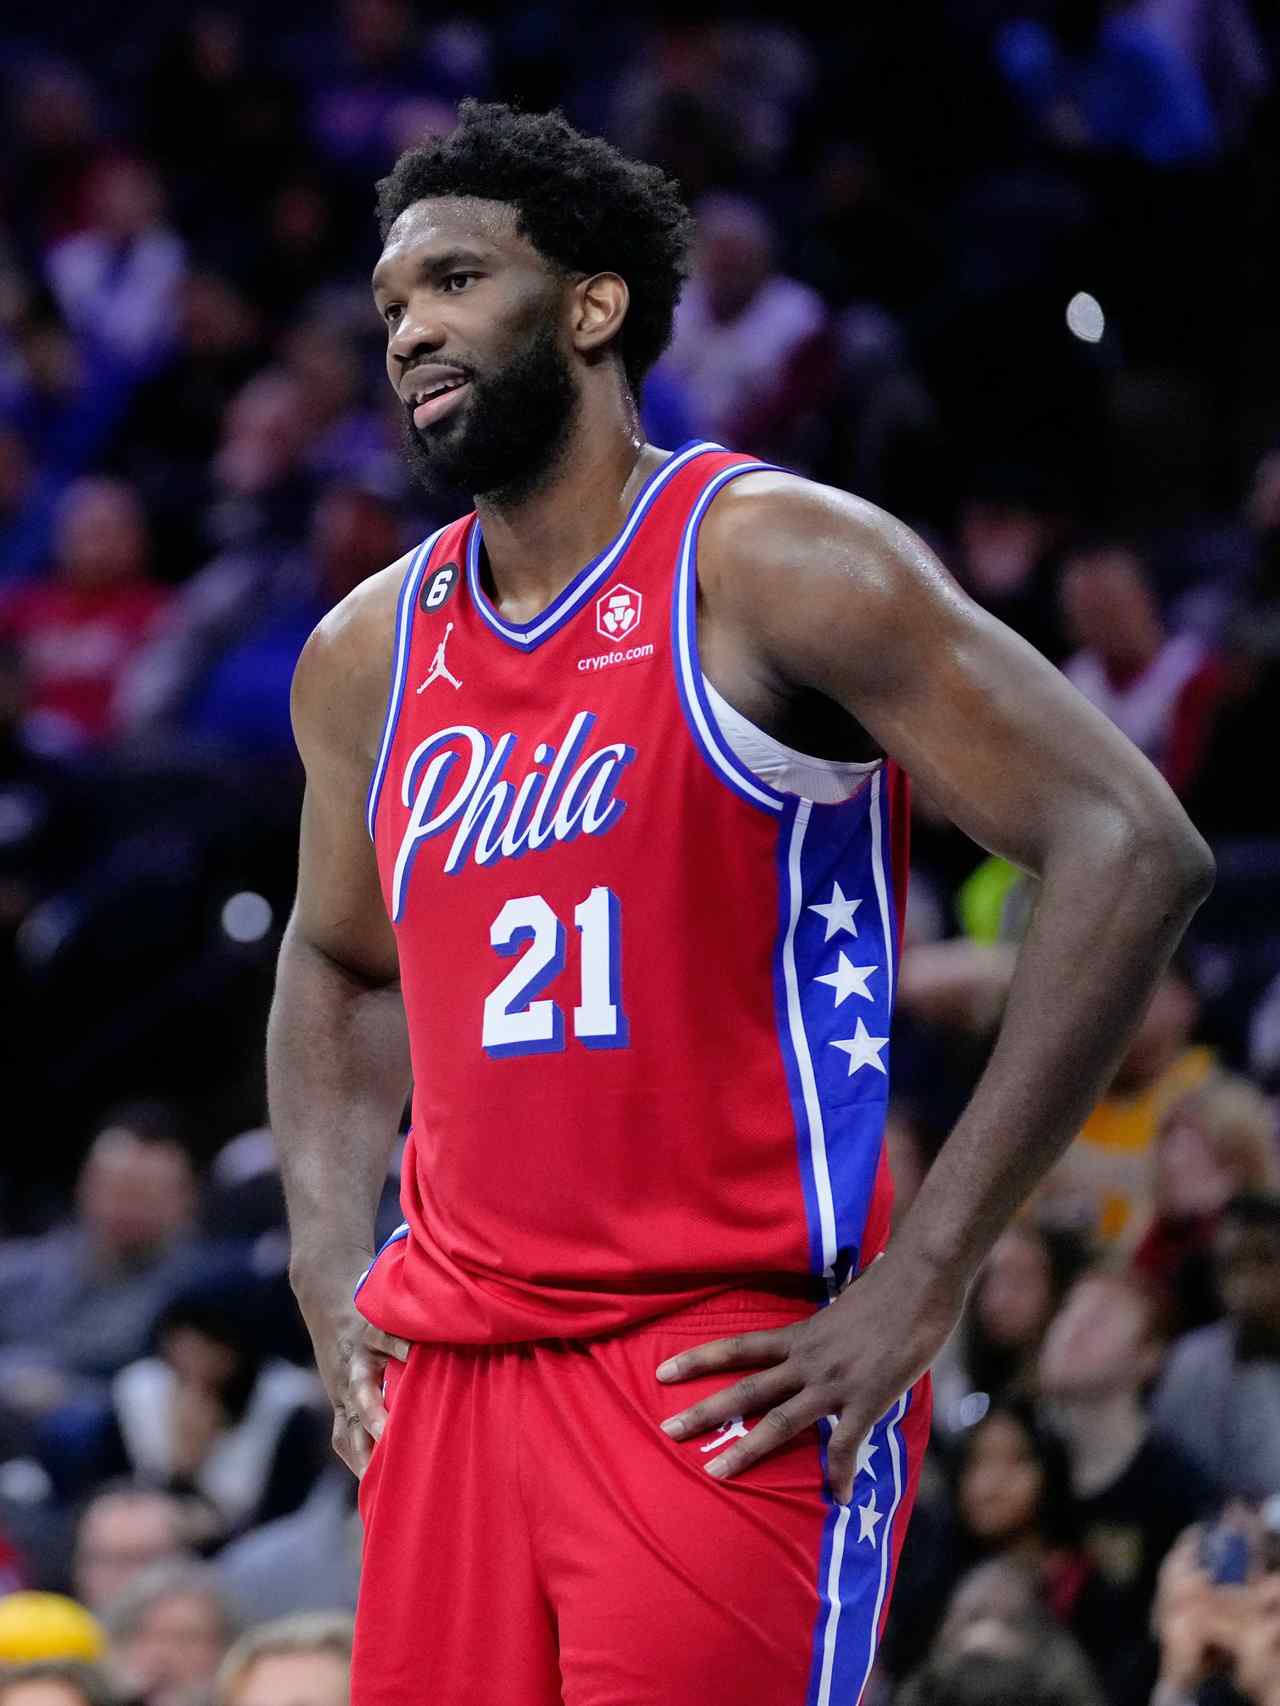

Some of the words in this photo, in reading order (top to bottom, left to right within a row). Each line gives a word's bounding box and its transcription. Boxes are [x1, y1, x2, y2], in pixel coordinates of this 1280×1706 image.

[425, 569, 453, 608] 6
[577, 643, 654, 673] crypto.com
[391, 711, 637, 924] Phila
[481, 885, 631, 1060] 21
